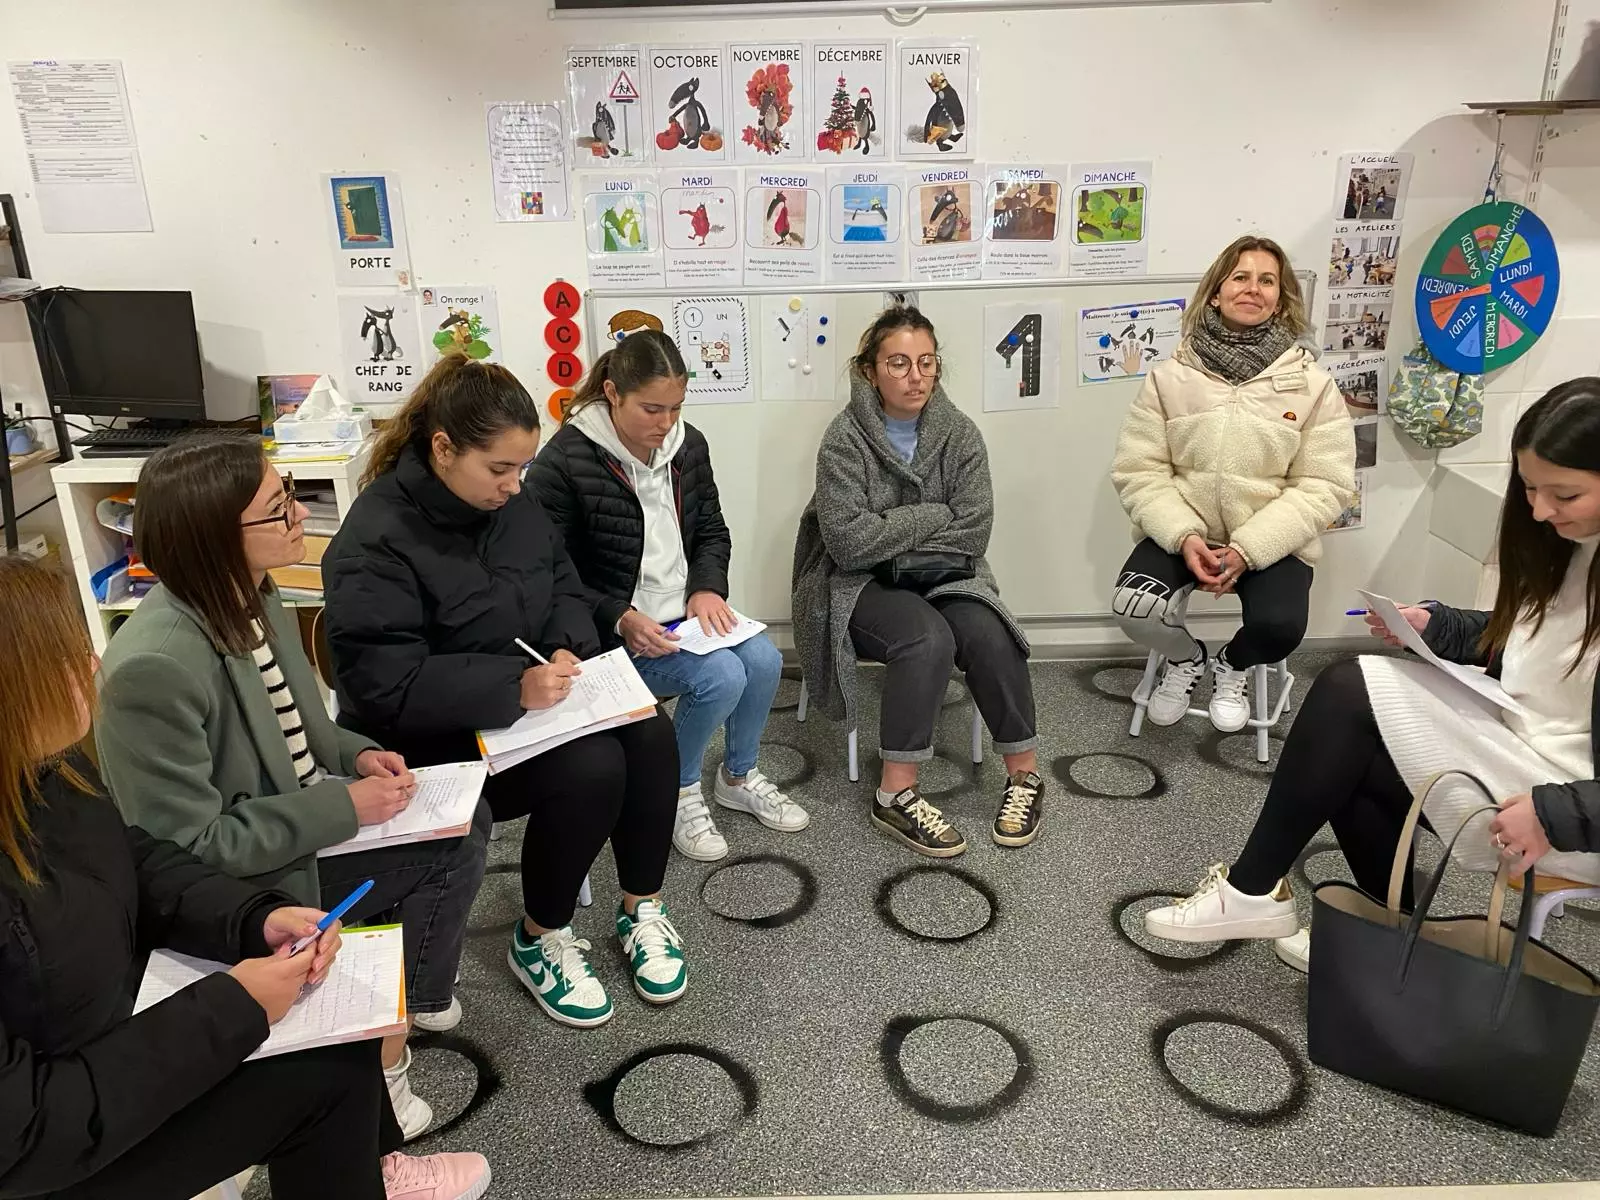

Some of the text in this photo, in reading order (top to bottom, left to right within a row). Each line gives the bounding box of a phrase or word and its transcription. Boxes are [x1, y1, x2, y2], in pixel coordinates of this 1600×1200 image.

[733, 48, 801, 63] NOVEMBRE
[818, 46, 883, 63] DÉCEMBRE
[908, 52, 962, 66] JANVIER
[571, 54, 637, 69] SEPTEMBRE
[653, 54, 719, 69] OCTOBRE
[1351, 155, 1398, 164] L'ACCUEIL
[852, 172, 878, 183] JEUDI
[921, 171, 968, 182] VENDREDI
[1008, 169, 1044, 179] SAMEDI
[1084, 172, 1136, 183] DIMANCHE
[605, 181, 633, 191] LUNDI
[681, 176, 713, 187] MARDI
[760, 176, 808, 187] MERCREDI
[1355, 223, 1397, 232] ATELIERS
[1486, 205, 1525, 272] DIMANCHE
[1460, 233, 1482, 280] SAMEDI
[350, 257, 391, 269] PORTE
[1499, 262, 1533, 284] LUNDI
[440, 295, 453, 304] On
[455, 297, 479, 306] range
[556, 291, 571, 308] A
[1331, 289, 1391, 300] LA MOTRICITÉ
[1499, 290, 1529, 319] MARDI
[690, 312, 695, 322] 1
[1449, 305, 1478, 340] JEUDI
[556, 326, 572, 344] C
[1484, 302, 1497, 358] MERCREDI
[355, 365, 413, 377] CHEF DE
[557, 361, 573, 378] D
[368, 381, 404, 393] RANG
